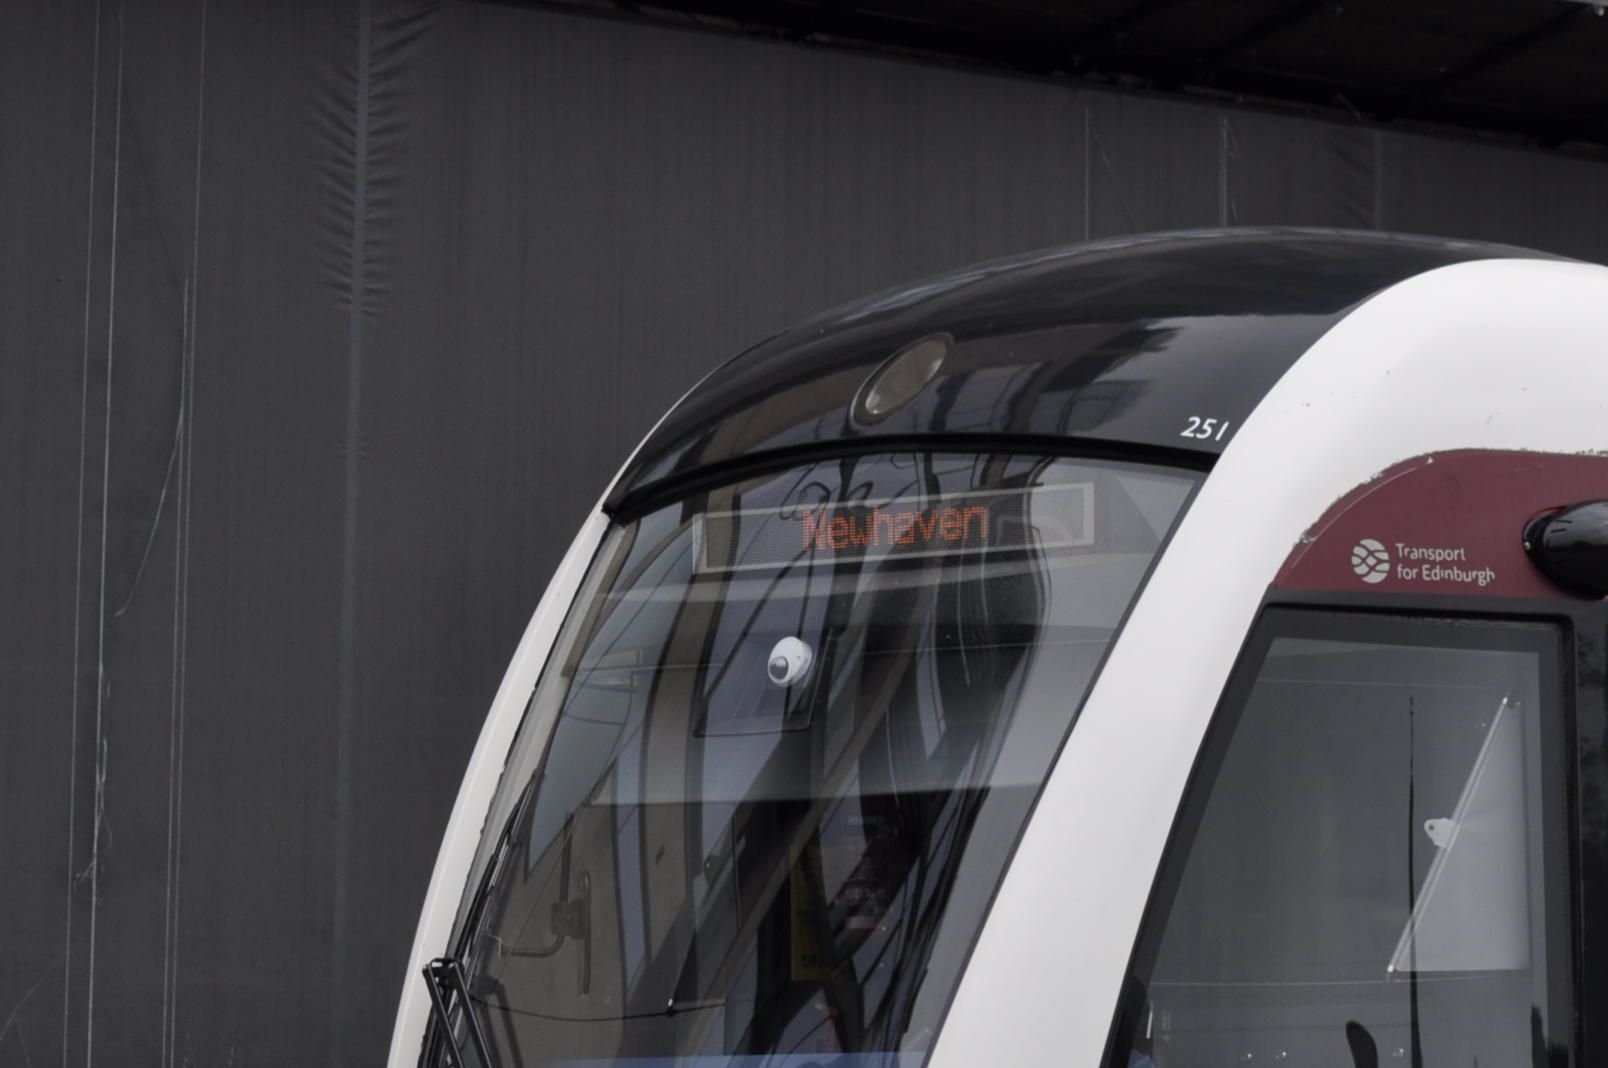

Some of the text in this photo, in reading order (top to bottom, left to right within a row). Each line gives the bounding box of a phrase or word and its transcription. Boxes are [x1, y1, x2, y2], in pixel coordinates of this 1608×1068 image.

[1180, 416, 1230, 442] 251
[803, 505, 988, 551] Newhaven
[1395, 543, 1466, 562] Transport
[1397, 564, 1496, 587] for Edinburgh
